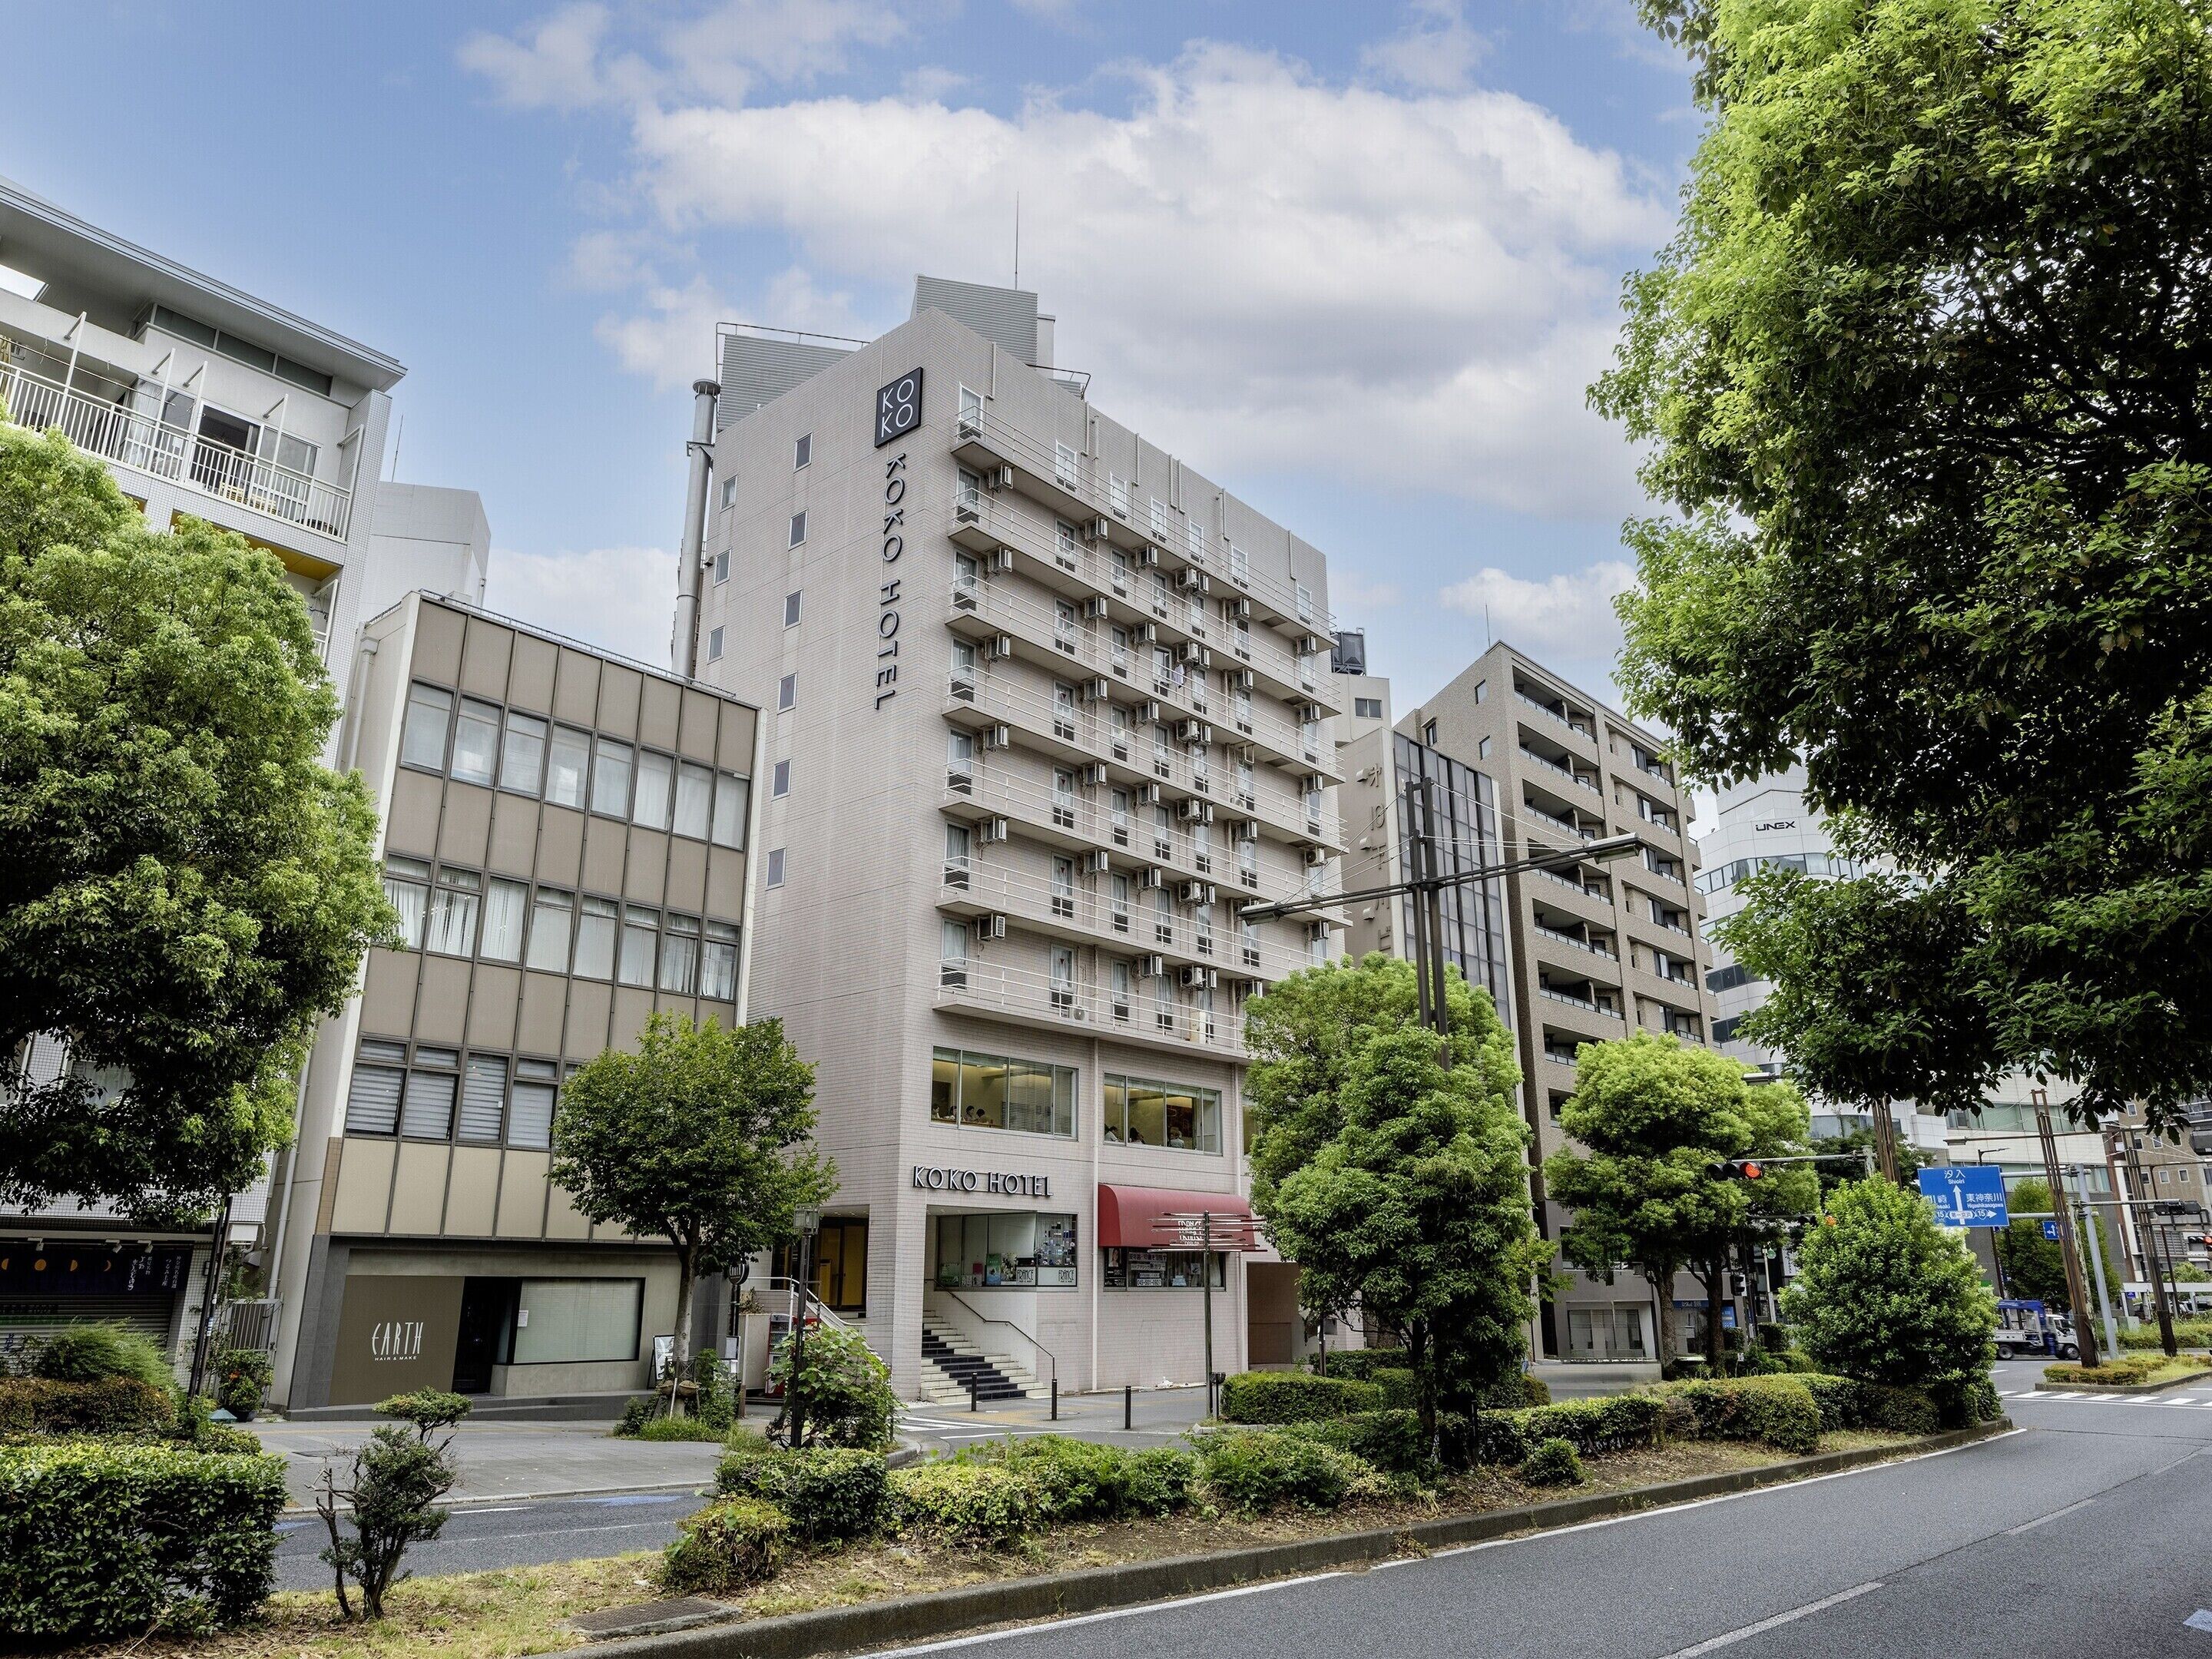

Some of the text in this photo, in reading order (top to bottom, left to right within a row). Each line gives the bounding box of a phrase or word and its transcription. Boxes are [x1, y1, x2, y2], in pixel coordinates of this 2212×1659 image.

[882, 378, 915, 413] KO
[880, 402, 913, 438] KO
[874, 452, 906, 710] KOKO HOTEL
[913, 1165, 1053, 1197] KOKO HOTEL
[1944, 1170, 1965, 1178] 汐入
[1966, 1193, 2002, 1202] 東神奈川
[372, 1322, 423, 1355] EARTH
